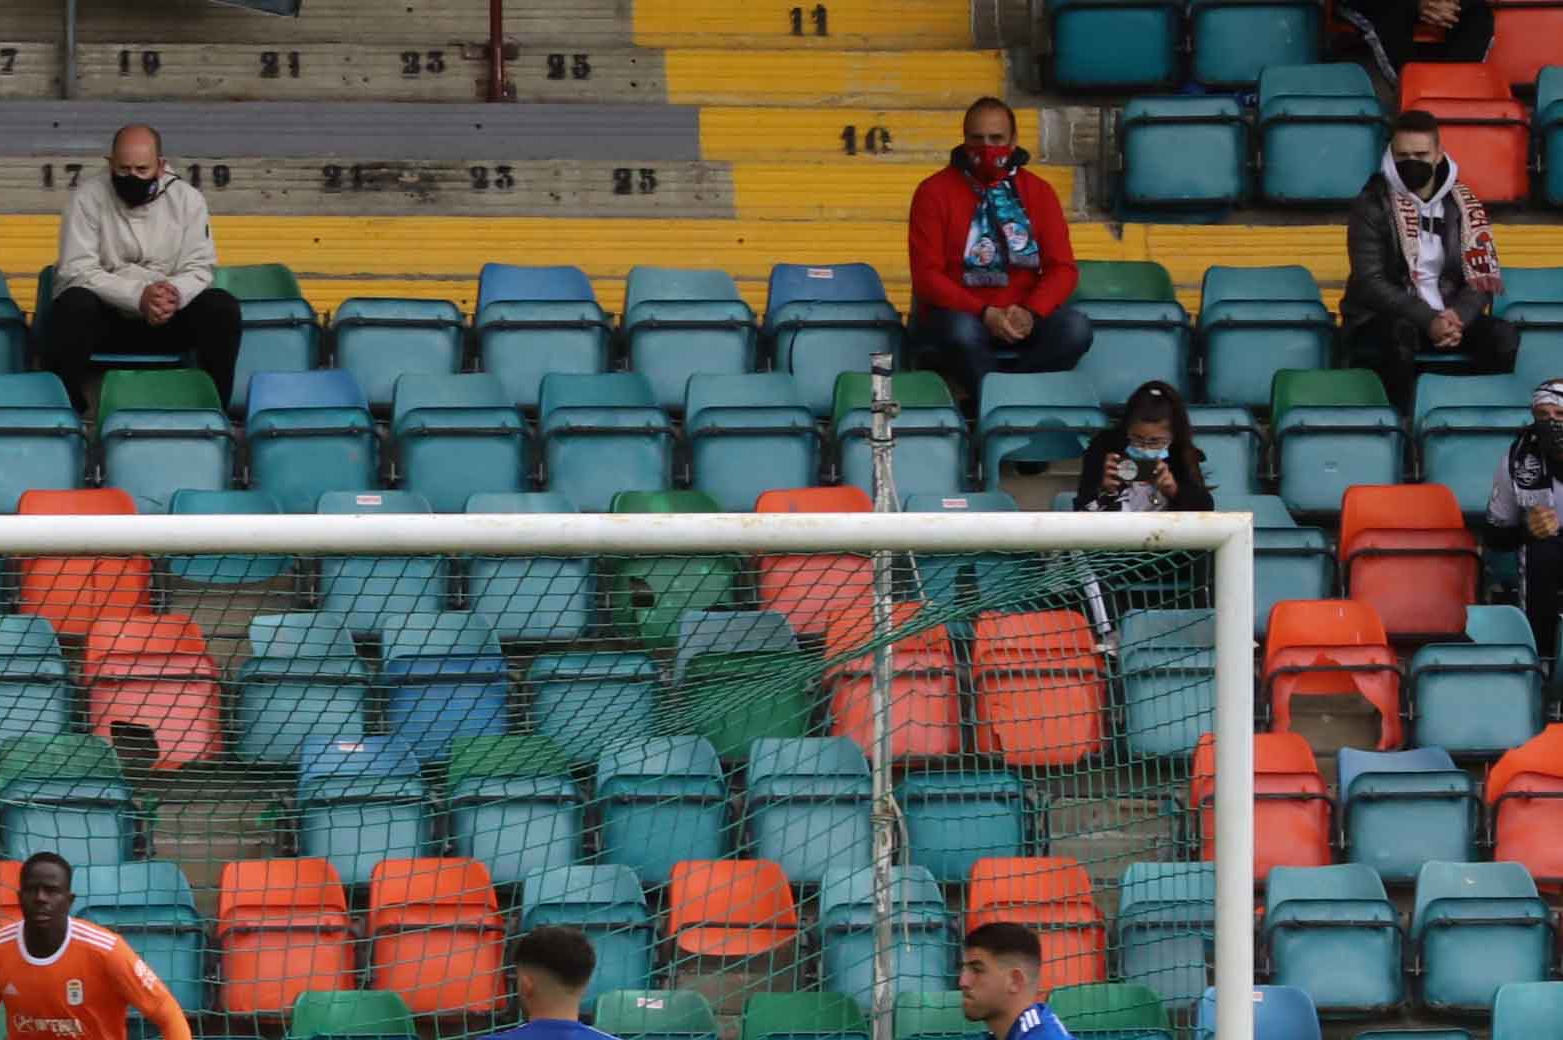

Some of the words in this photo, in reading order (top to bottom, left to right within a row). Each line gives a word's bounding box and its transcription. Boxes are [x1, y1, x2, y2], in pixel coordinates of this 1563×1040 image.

[788, 4, 830, 37] 11
[118, 50, 161, 76] 19
[259, 51, 300, 78] 21
[400, 51, 446, 77] 23
[546, 53, 591, 80] 25
[839, 124, 893, 156] 10
[41, 163, 82, 188] 17
[186, 163, 230, 189] 19
[468, 165, 516, 191] 23
[612, 167, 658, 195] 25
